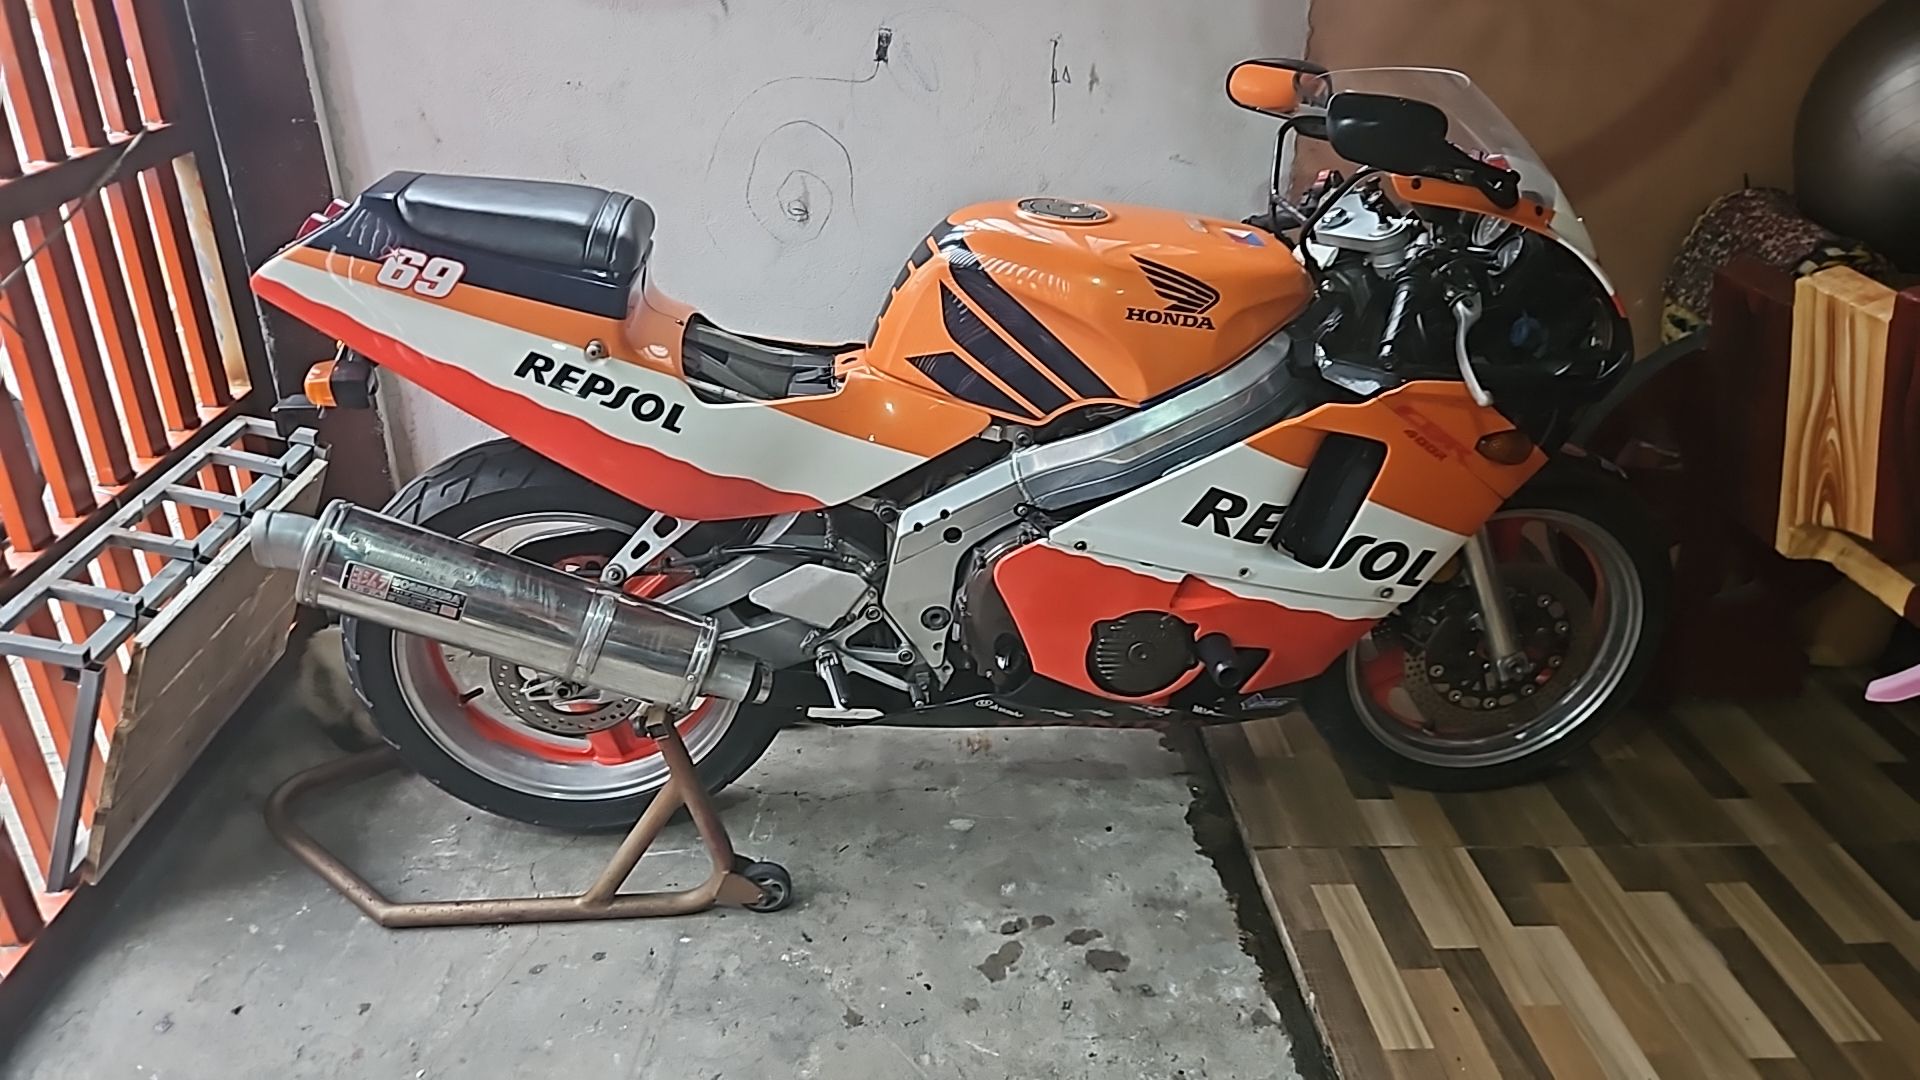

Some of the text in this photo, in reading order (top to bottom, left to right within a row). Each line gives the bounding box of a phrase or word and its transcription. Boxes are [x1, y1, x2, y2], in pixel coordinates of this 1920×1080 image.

[377, 248, 465, 298] 69
[1125, 307, 1216, 330] HONDA
[513, 351, 686, 434] REPSOL
